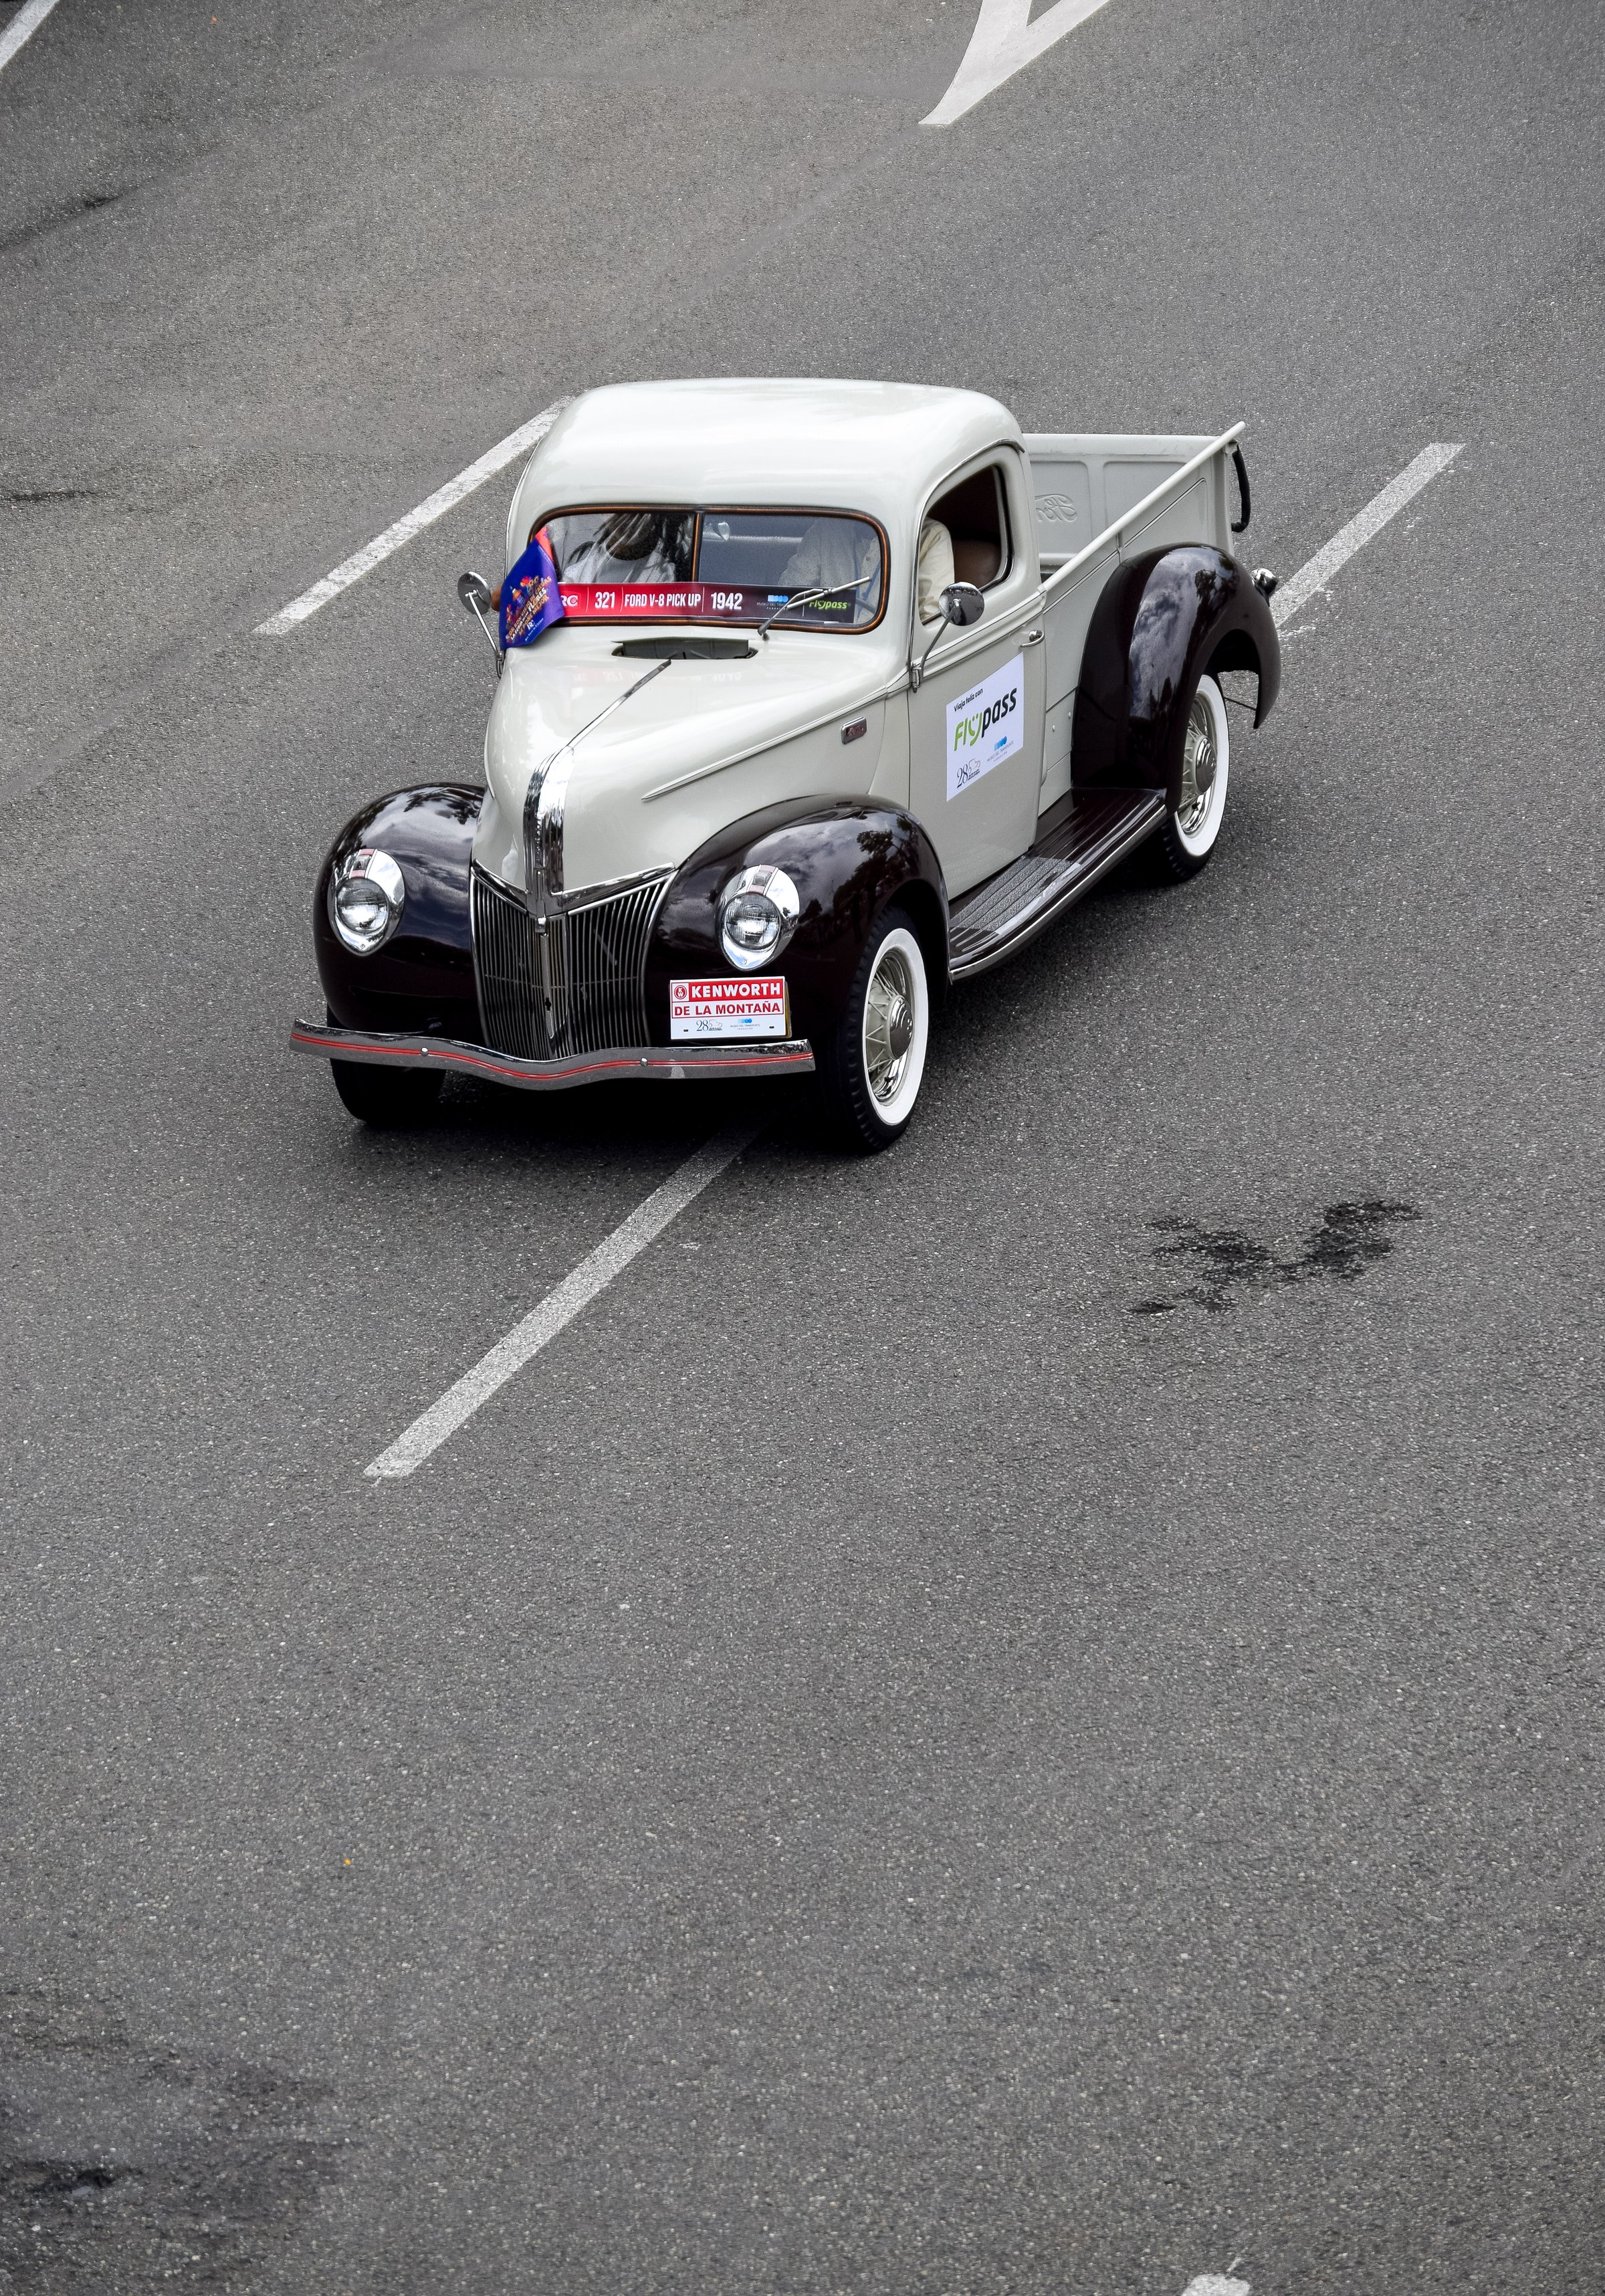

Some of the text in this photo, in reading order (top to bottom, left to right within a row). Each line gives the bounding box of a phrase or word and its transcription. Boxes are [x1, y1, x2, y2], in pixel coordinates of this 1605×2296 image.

[528, 587, 548, 613] FLORES
[595, 591, 615, 609] 321
[625, 593, 702, 607] FORD V-8 PICK UP
[711, 593, 742, 610] 1942
[954, 688, 984, 712] Viaja feliz con
[954, 688, 1017, 751] Flypass
[956, 764, 968, 789] 28
[691, 982, 780, 998] KENWORTH
[674, 1001, 780, 1016] DE LA MONTAÑA
[696, 1019, 709, 1031] 28
